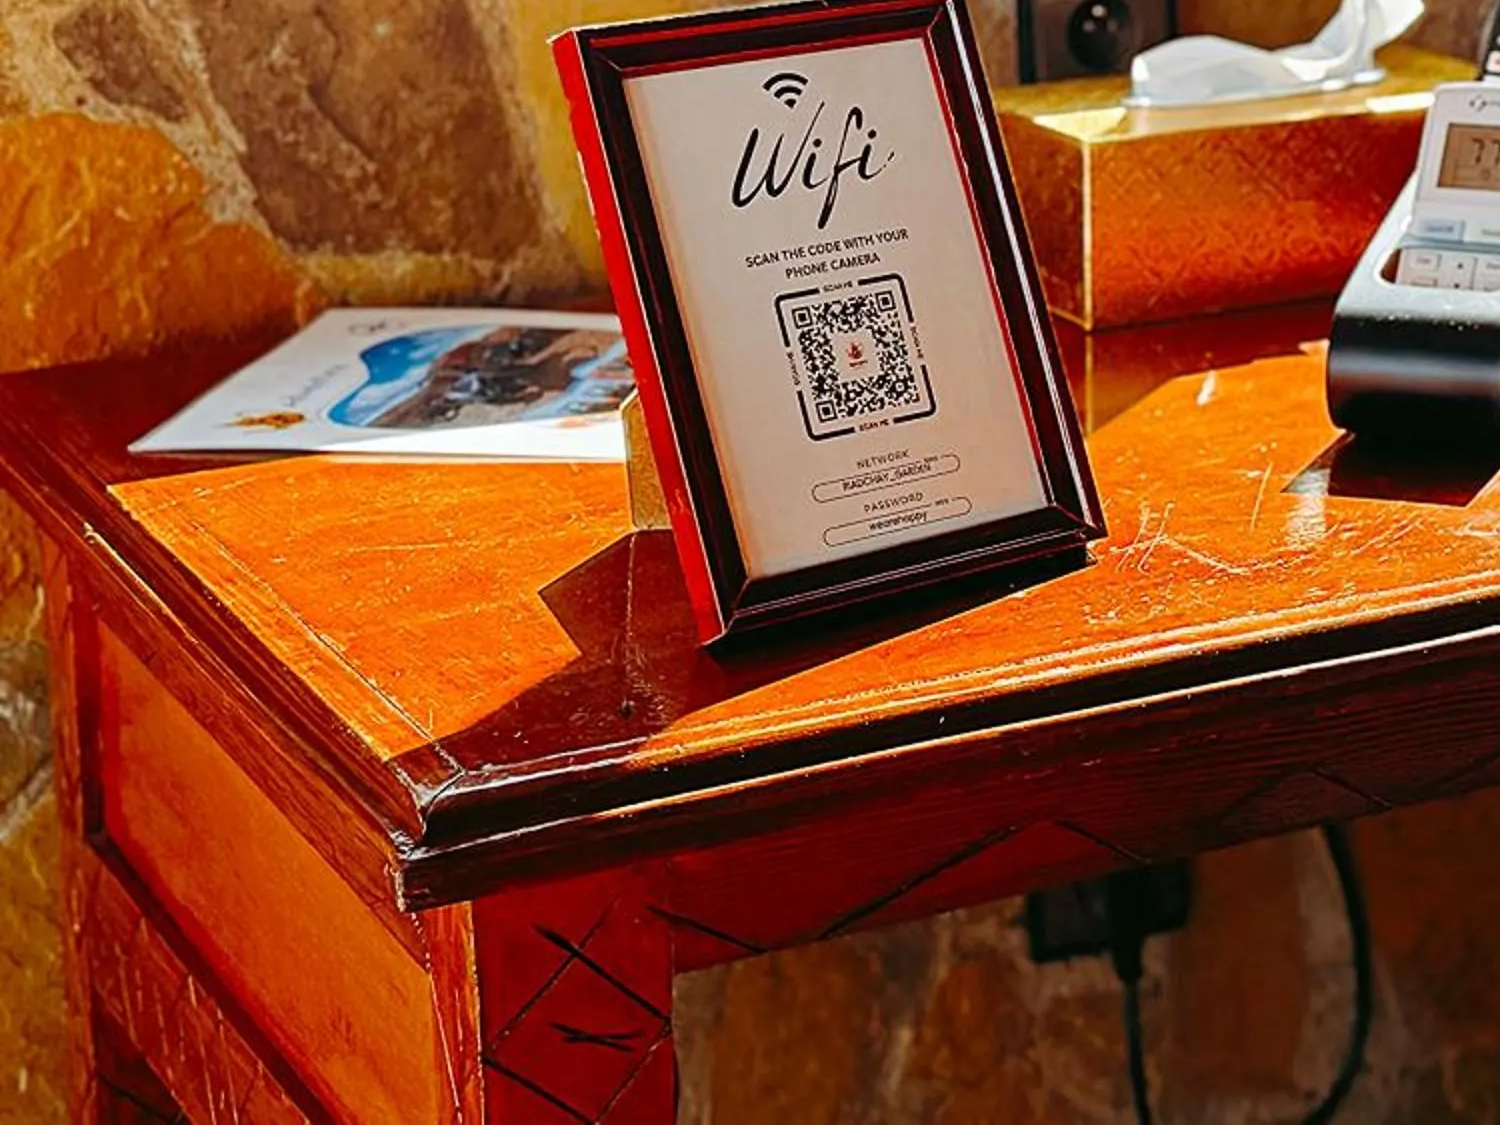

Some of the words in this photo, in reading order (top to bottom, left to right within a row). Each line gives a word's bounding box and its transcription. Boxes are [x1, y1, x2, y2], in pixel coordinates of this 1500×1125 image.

[732, 101, 894, 229] Wifi
[745, 249, 780, 268] SCAN
[781, 245, 806, 262] THE
[807, 240, 842, 257] CODE
[843, 233, 875, 251] WITH
[875, 228, 909, 244] YOUR
[785, 261, 829, 279] PHONE
[831, 252, 880, 270] CAMERA
[856, 449, 911, 469] NETWORK
[864, 492, 924, 513] PASSWORD
